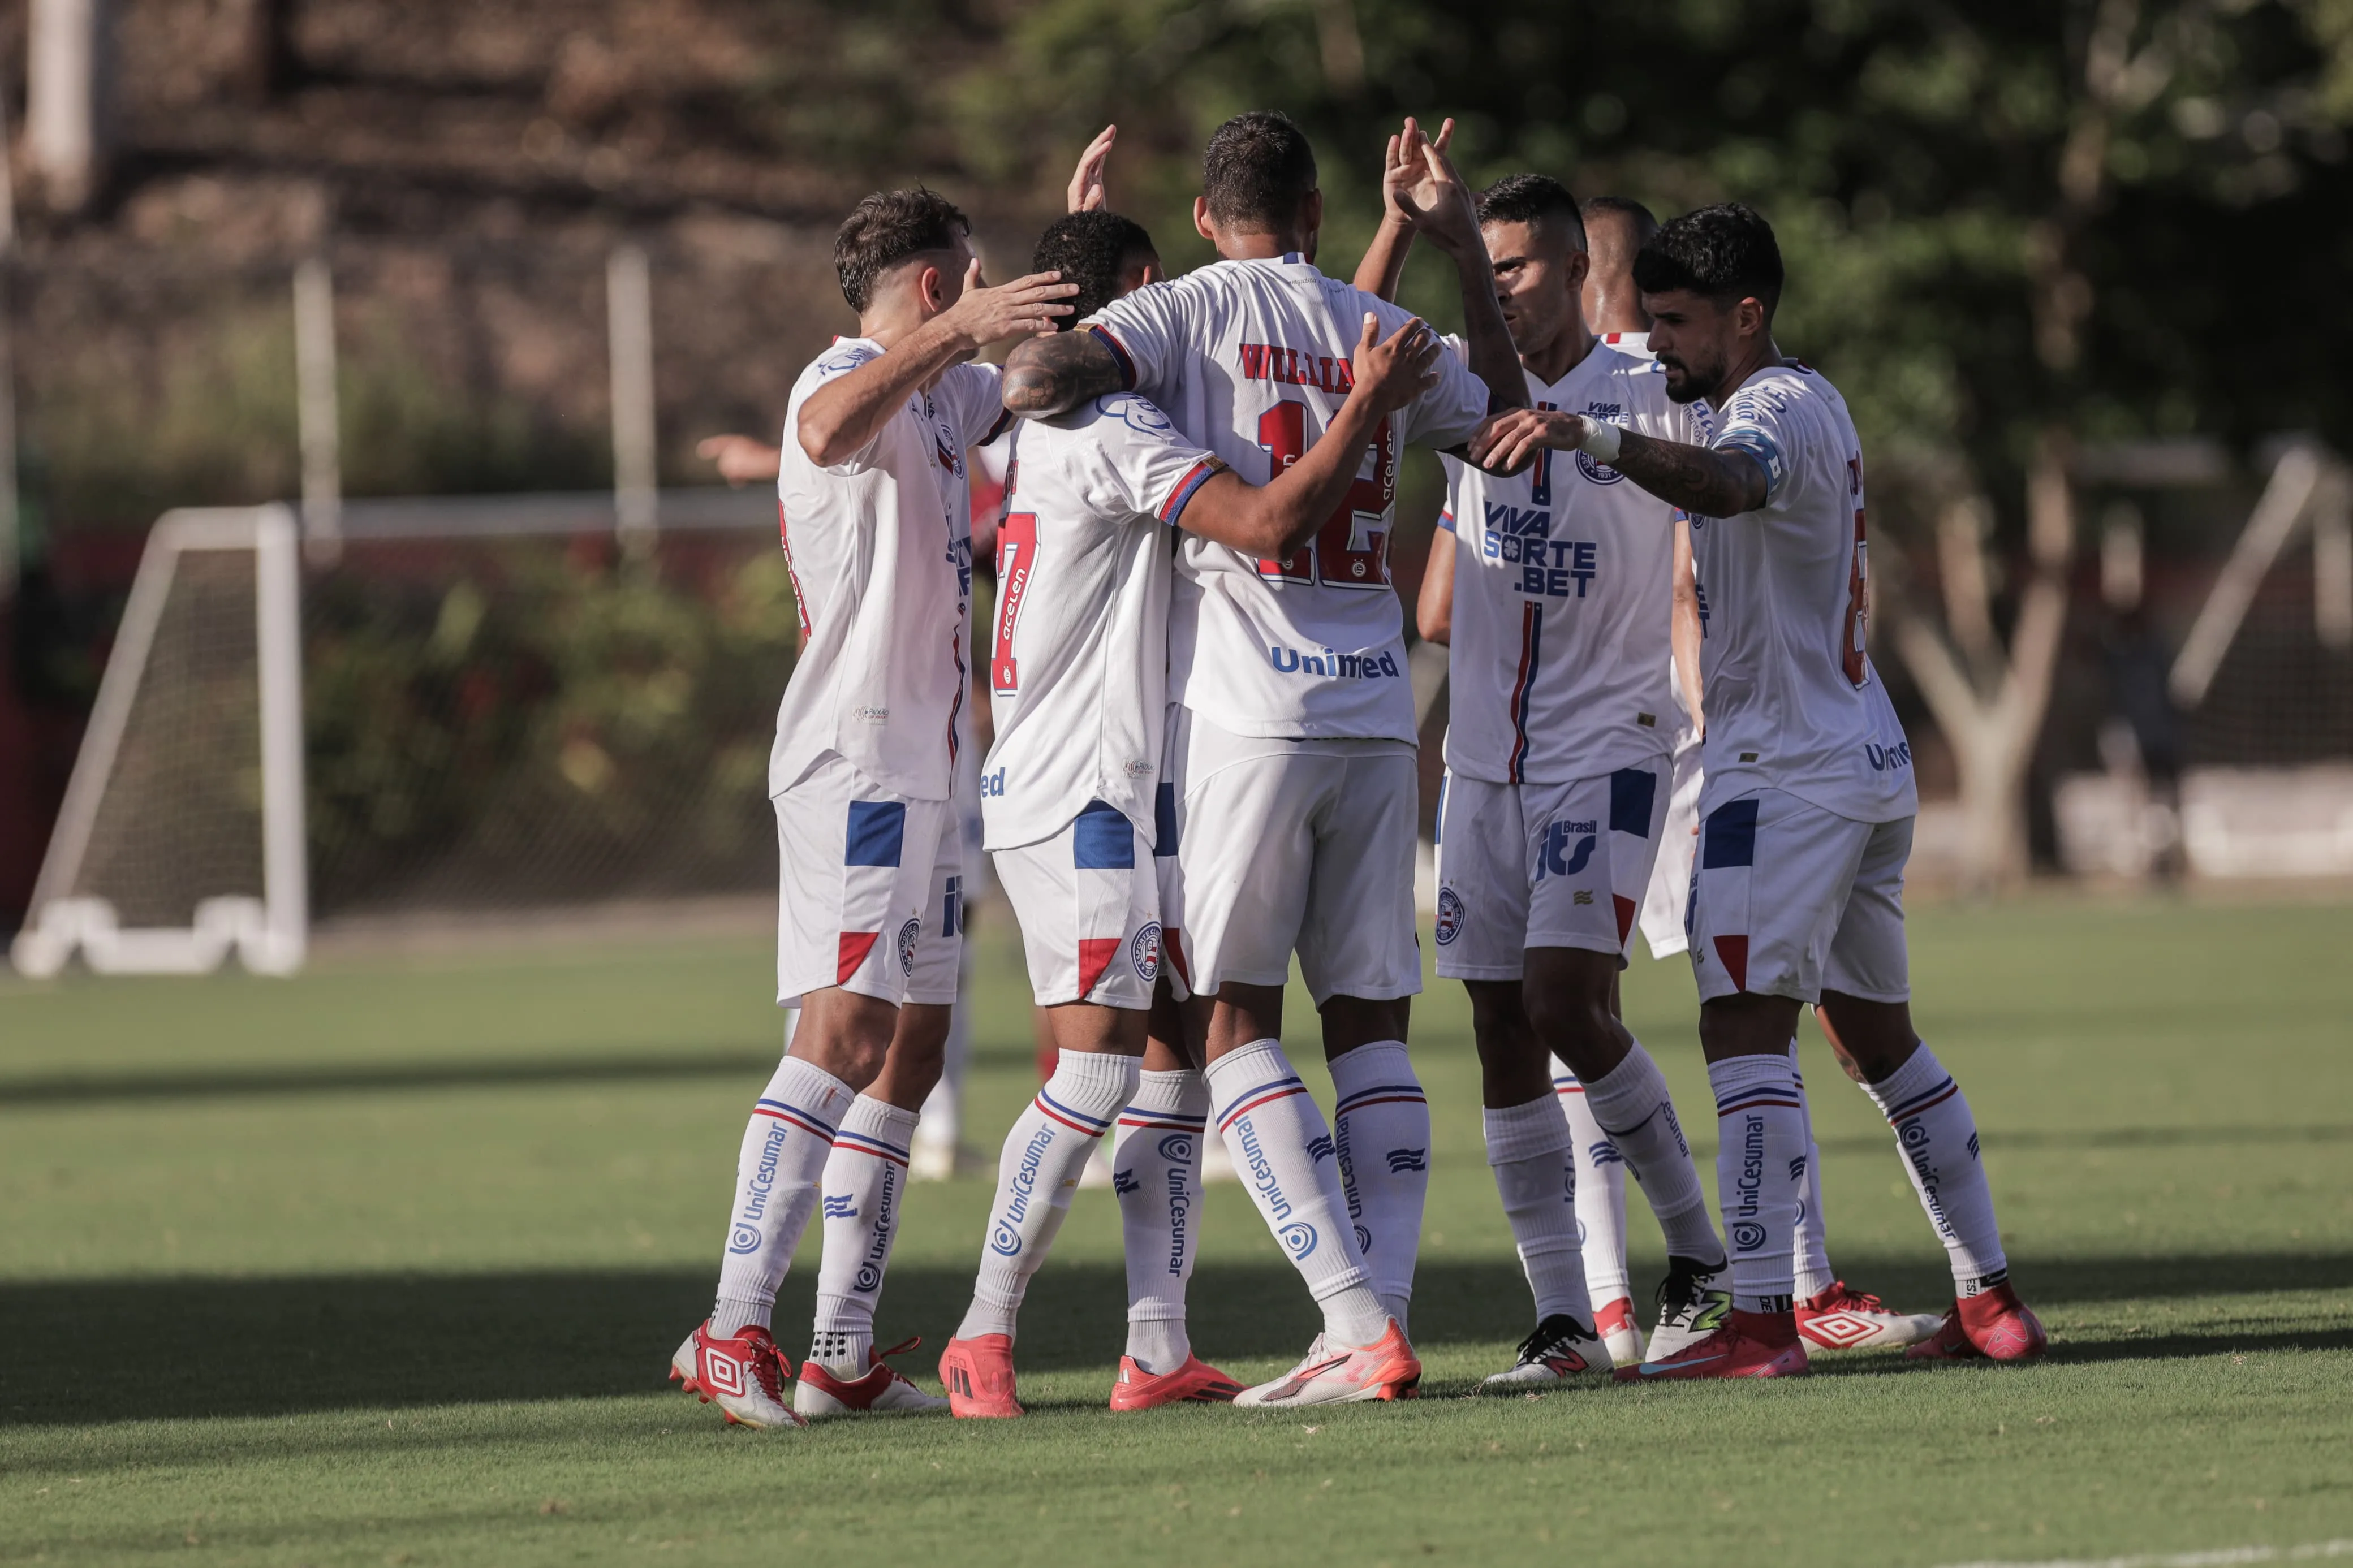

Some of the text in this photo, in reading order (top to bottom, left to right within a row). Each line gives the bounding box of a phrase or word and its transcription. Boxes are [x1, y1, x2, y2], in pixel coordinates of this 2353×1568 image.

[1238, 343, 1356, 394] WILLIA
[1588, 402, 1621, 414] VIVA
[1484, 500, 1551, 538] VIVA
[1484, 529, 1597, 570] SORTE
[992, 512, 1041, 697] 7
[1514, 566, 1596, 598] .BET
[1271, 647, 1400, 679] Unimed
[1563, 820, 1597, 833] Brasil
[1136, 930, 1150, 965] ESPORTE
[743, 1121, 788, 1220] UniCesumar
[1007, 1122, 1056, 1223] UniCesumar
[1232, 1115, 1292, 1221] UniCesumar
[1736, 1114, 1764, 1217] UniCesumar
[1911, 1149, 1956, 1239] UniCesumar
[870, 1160, 896, 1260] UniCesumar
[1167, 1168, 1190, 1278] UniCesumar
